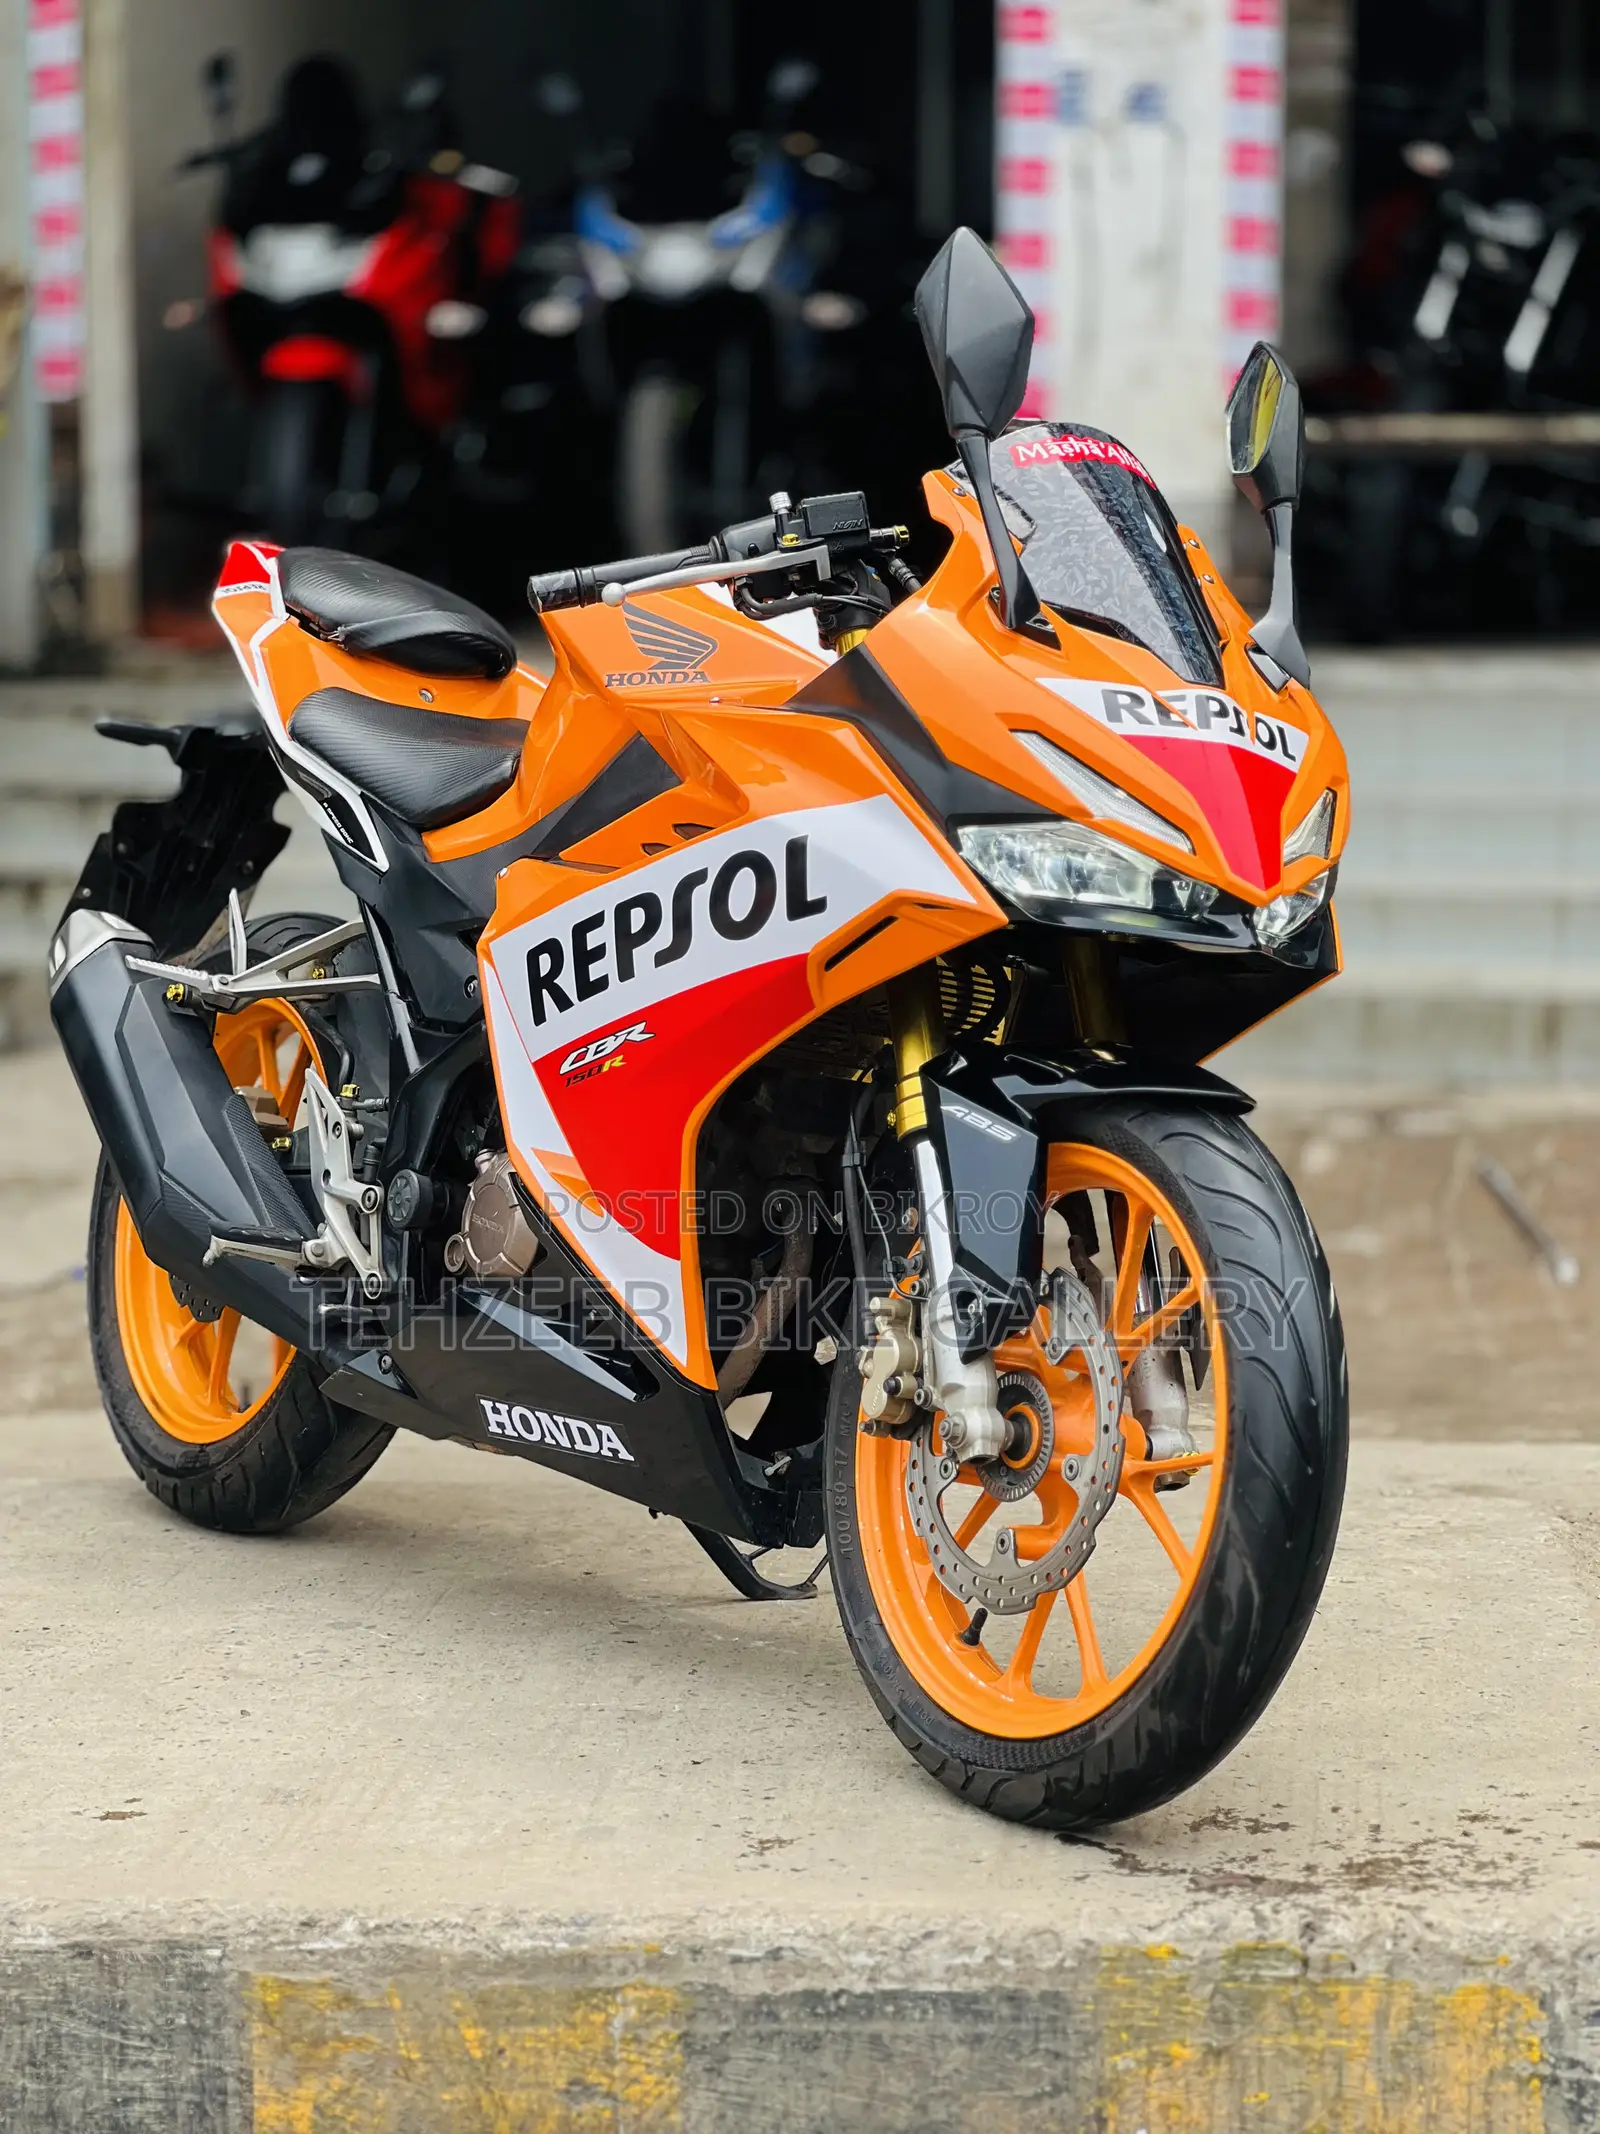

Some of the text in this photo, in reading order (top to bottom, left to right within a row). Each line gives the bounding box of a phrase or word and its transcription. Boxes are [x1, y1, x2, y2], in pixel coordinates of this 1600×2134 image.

[605, 669, 711, 689] HONDA
[1101, 688, 1297, 763] REPSOL
[525, 834, 828, 1028] REPSOL
[559, 1020, 657, 1076] CBR
[565, 1054, 627, 1089] 150R
[940, 1105, 1018, 1141] ABS
[478, 1397, 636, 1463] HONDA
[834, 1447, 854, 1556] 100/80-17
